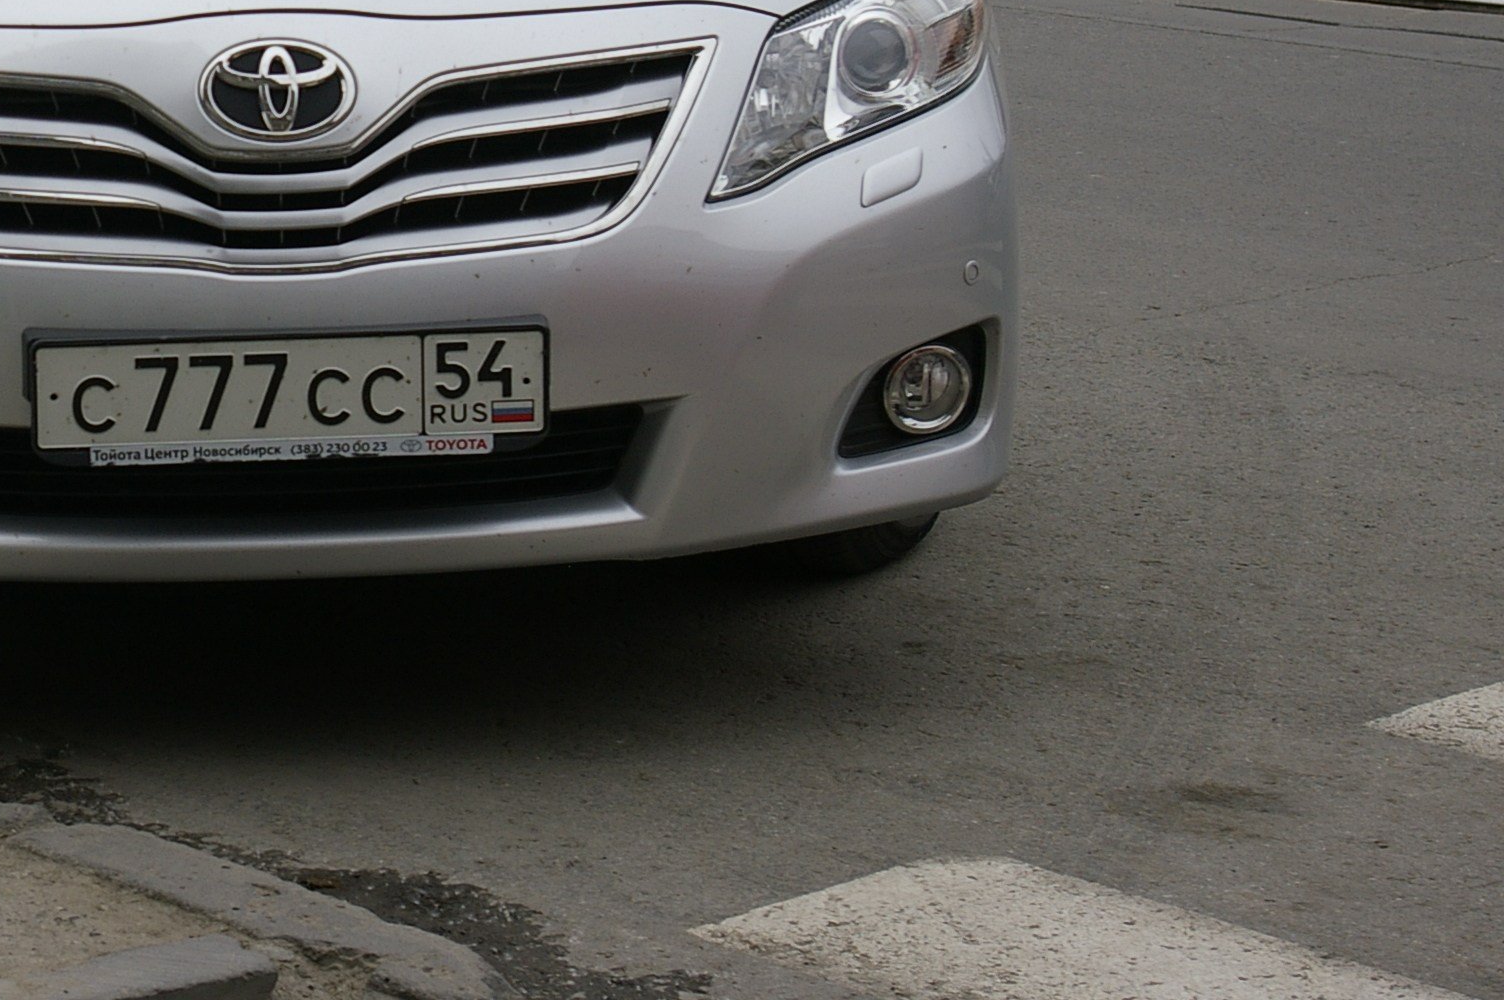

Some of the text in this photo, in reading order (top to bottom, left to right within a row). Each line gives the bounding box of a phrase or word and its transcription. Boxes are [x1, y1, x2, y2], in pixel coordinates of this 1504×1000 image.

[435, 340, 513, 399] 54
[430, 402, 488, 424] RUS
[93, 446, 141, 461] Тойота
[144, 447, 188, 461] Центр
[193, 444, 282, 458] Новосибирск
[290, 443, 324, 456] (383)
[326, 442, 350, 454] 230
[372, 441, 388, 452] 23
[426, 438, 488, 451] TOYOTA
